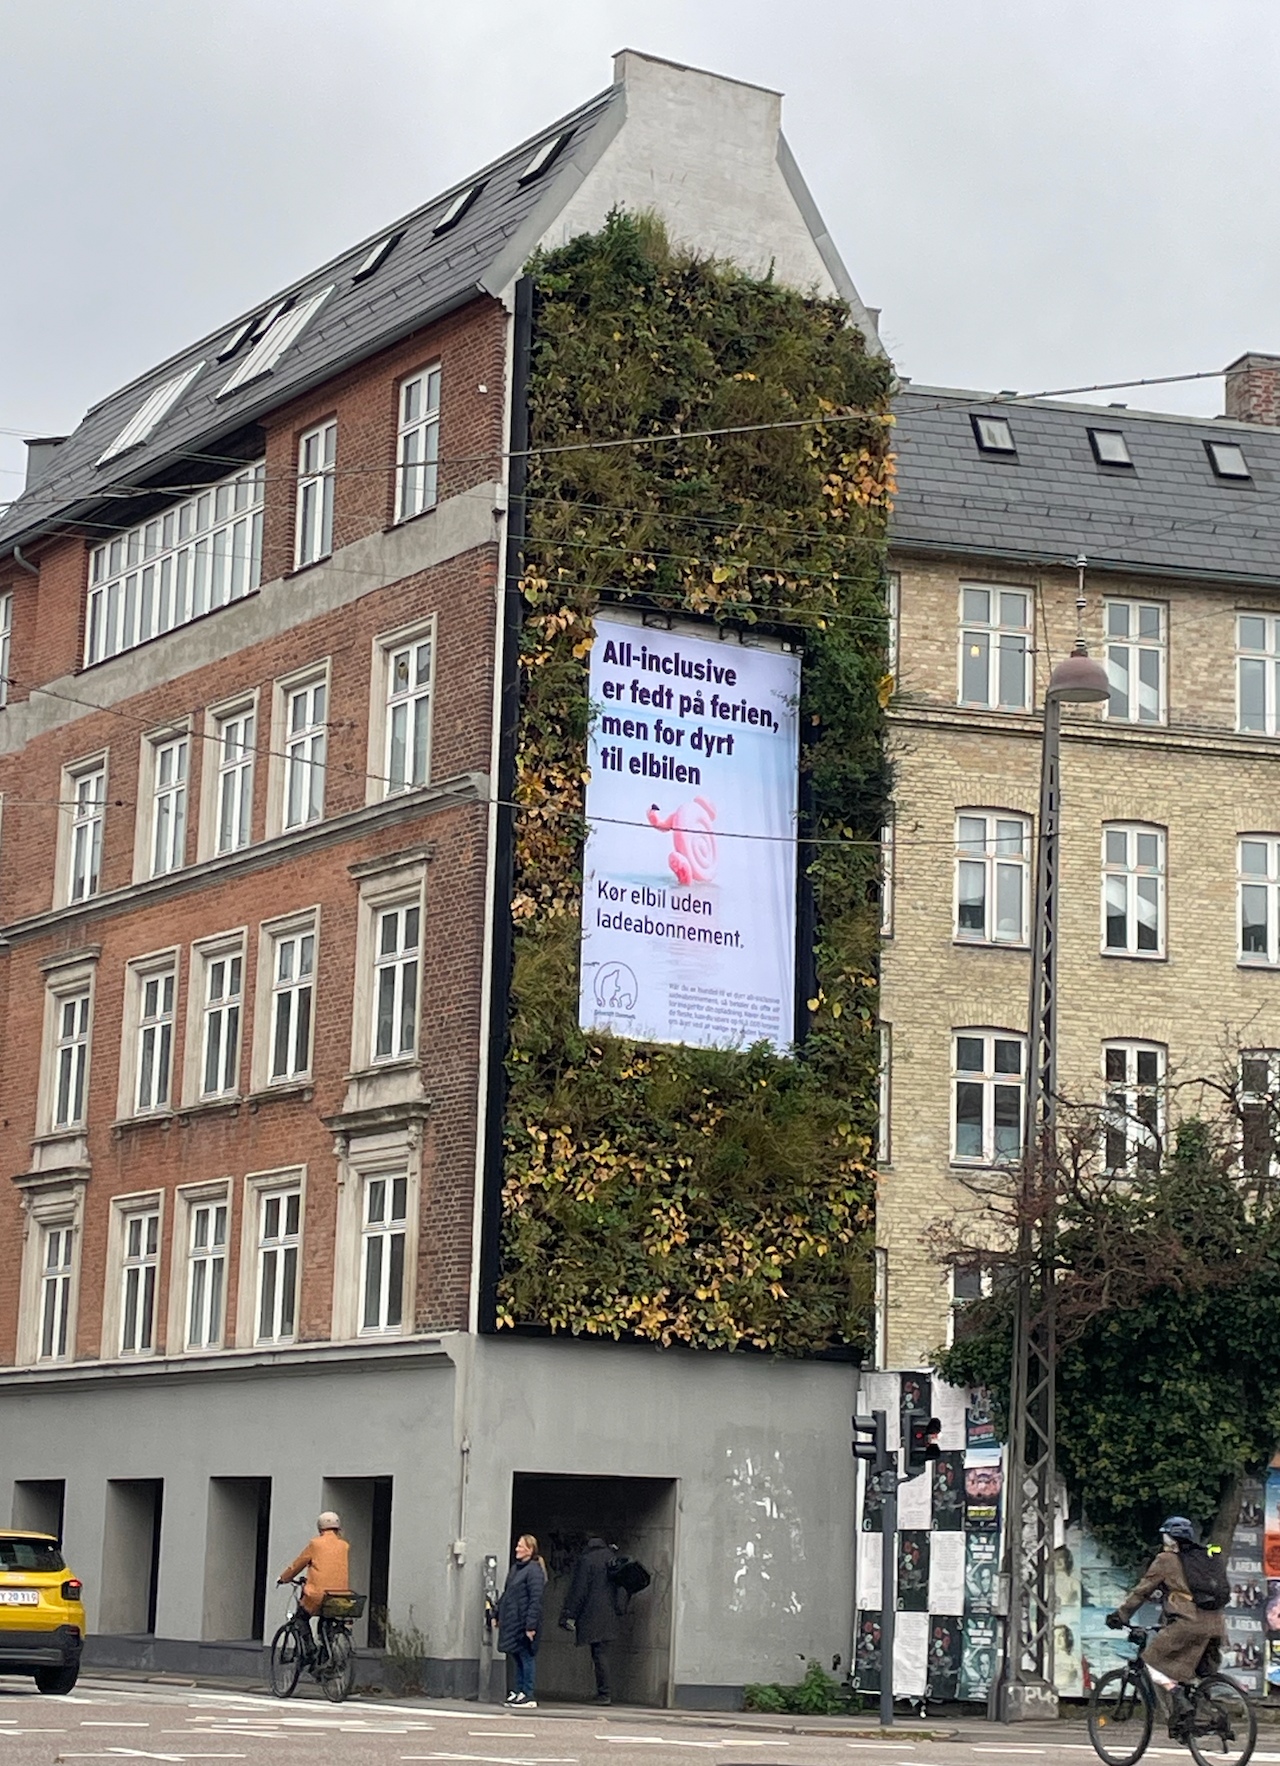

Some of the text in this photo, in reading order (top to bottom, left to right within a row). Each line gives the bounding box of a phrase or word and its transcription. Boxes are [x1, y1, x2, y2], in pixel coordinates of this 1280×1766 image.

[602, 640, 737, 687] All-inclusive
[602, 679, 779, 734] er fedt på ferien,
[601, 715, 735, 758] men for dyrt
[601, 746, 701, 785] til elbilen
[598, 879, 712, 916] Kør elbil uden
[596, 908, 745, 949] ladeabonnement.
